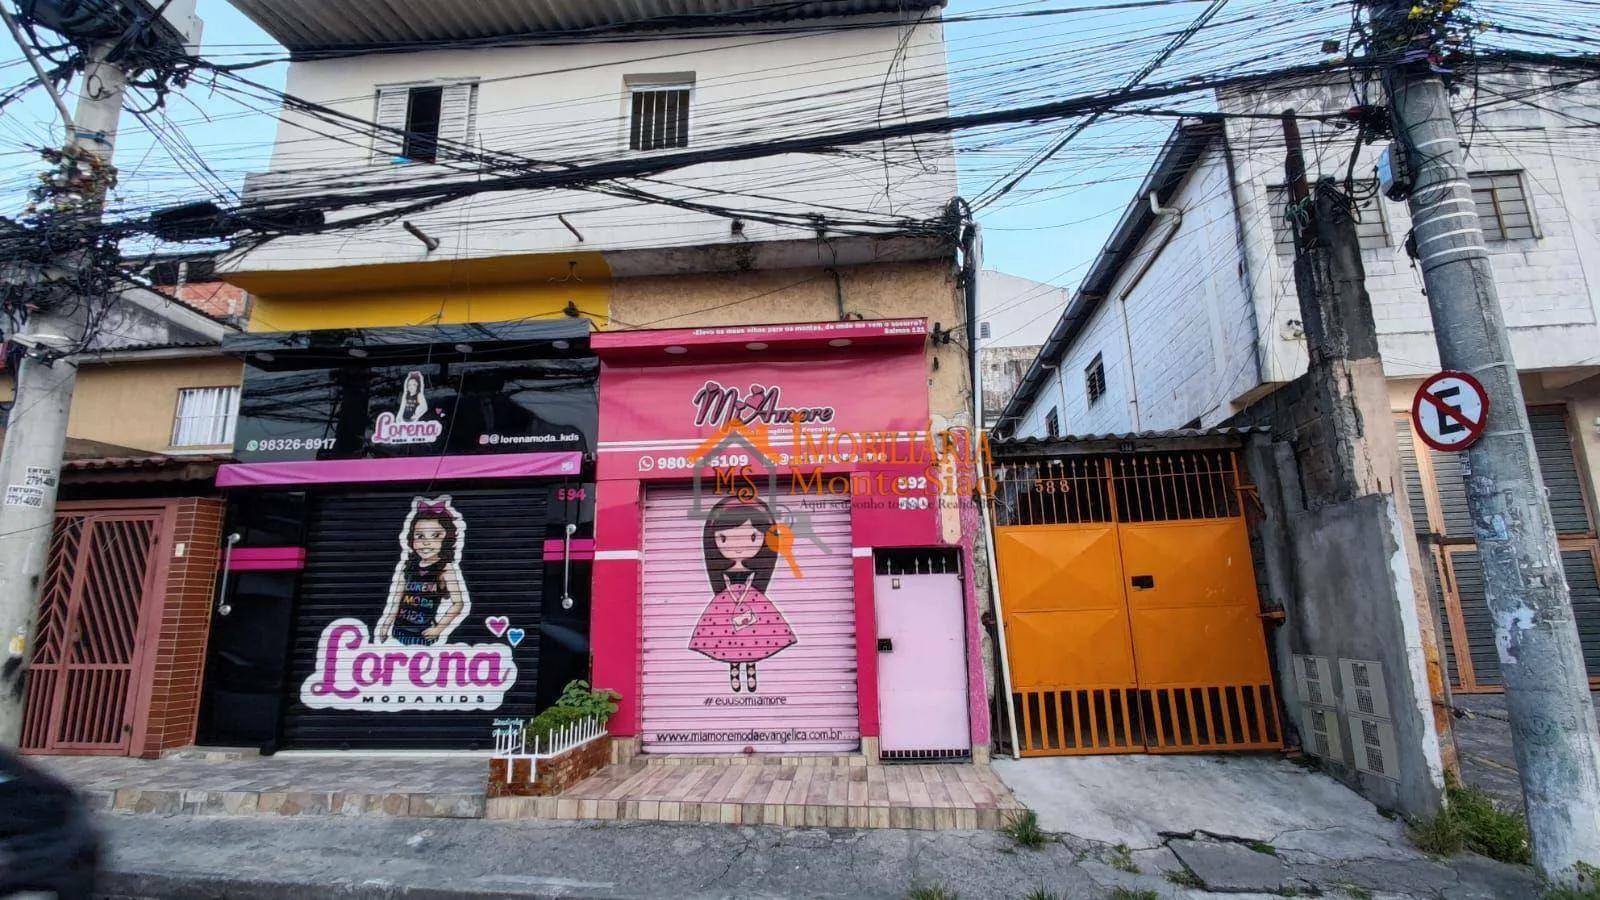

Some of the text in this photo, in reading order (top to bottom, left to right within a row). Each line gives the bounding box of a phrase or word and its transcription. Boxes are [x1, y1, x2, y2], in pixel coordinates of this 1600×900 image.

[1433, 386, 1466, 436] E
[372, 413, 438, 441] Lorena
[259, 438, 337, 451] 98326-8917
[1034, 479, 1070, 493] 588
[556, 487, 587, 501] 594
[310, 624, 512, 698] Lorena
[362, 694, 486, 704] MODA KIDS
